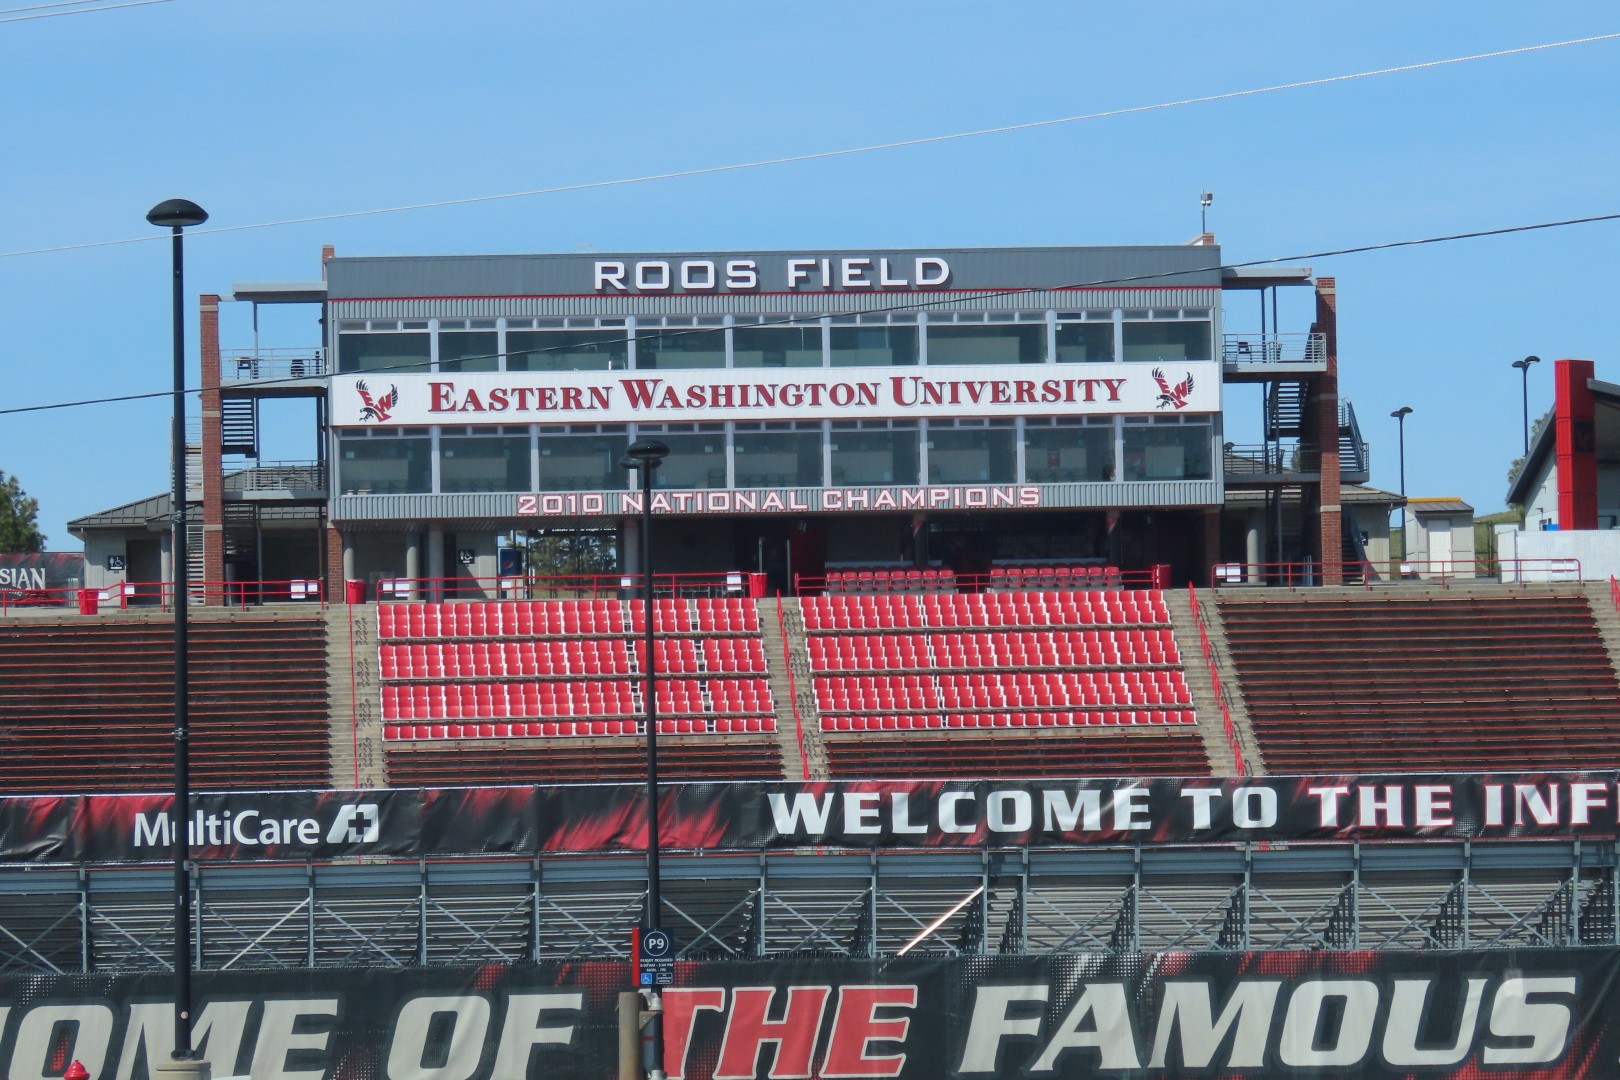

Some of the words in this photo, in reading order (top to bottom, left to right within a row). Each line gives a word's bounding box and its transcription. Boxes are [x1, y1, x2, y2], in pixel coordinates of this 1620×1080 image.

[594, 260, 757, 290] ROOS
[787, 257, 950, 288] FIELD
[428, 382, 613, 412] EASTERN
[619, 379, 881, 410] WASHINGTON
[889, 376, 1127, 406] UNIVERSITY
[518, 494, 604, 515] 2010
[621, 491, 808, 513] NATIONAL
[822, 487, 1040, 509] CHAMPIONS
[767, 788, 1152, 835] WELCOME
[1181, 786, 1278, 829] TO
[1308, 785, 1453, 828] THE
[1484, 782, 1620, 826] INF
[648, 938, 665, 949] P9
[0, 999, 338, 1080] OME
[387, 993, 583, 1080] OF
[638, 985, 918, 1080] THE
[958, 976, 1576, 1074] FAMOUS
